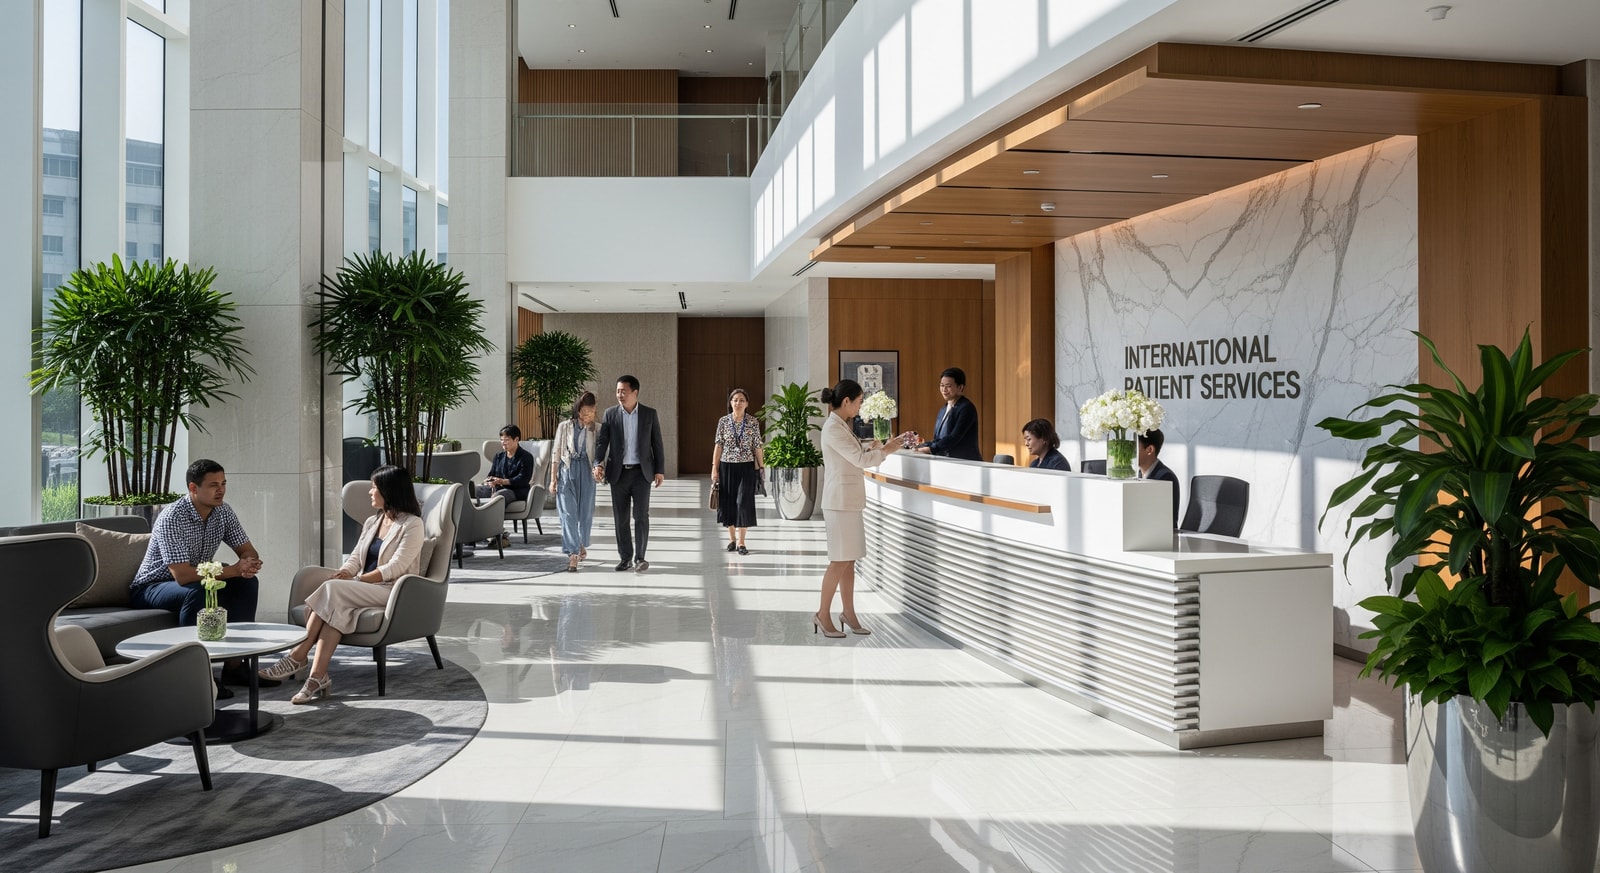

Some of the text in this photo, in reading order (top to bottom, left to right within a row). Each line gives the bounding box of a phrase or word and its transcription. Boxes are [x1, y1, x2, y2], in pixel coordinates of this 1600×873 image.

[1125, 335, 1276, 369] INTERNATIONAL
[1125, 371, 1300, 399] PATIENT SERVICES
